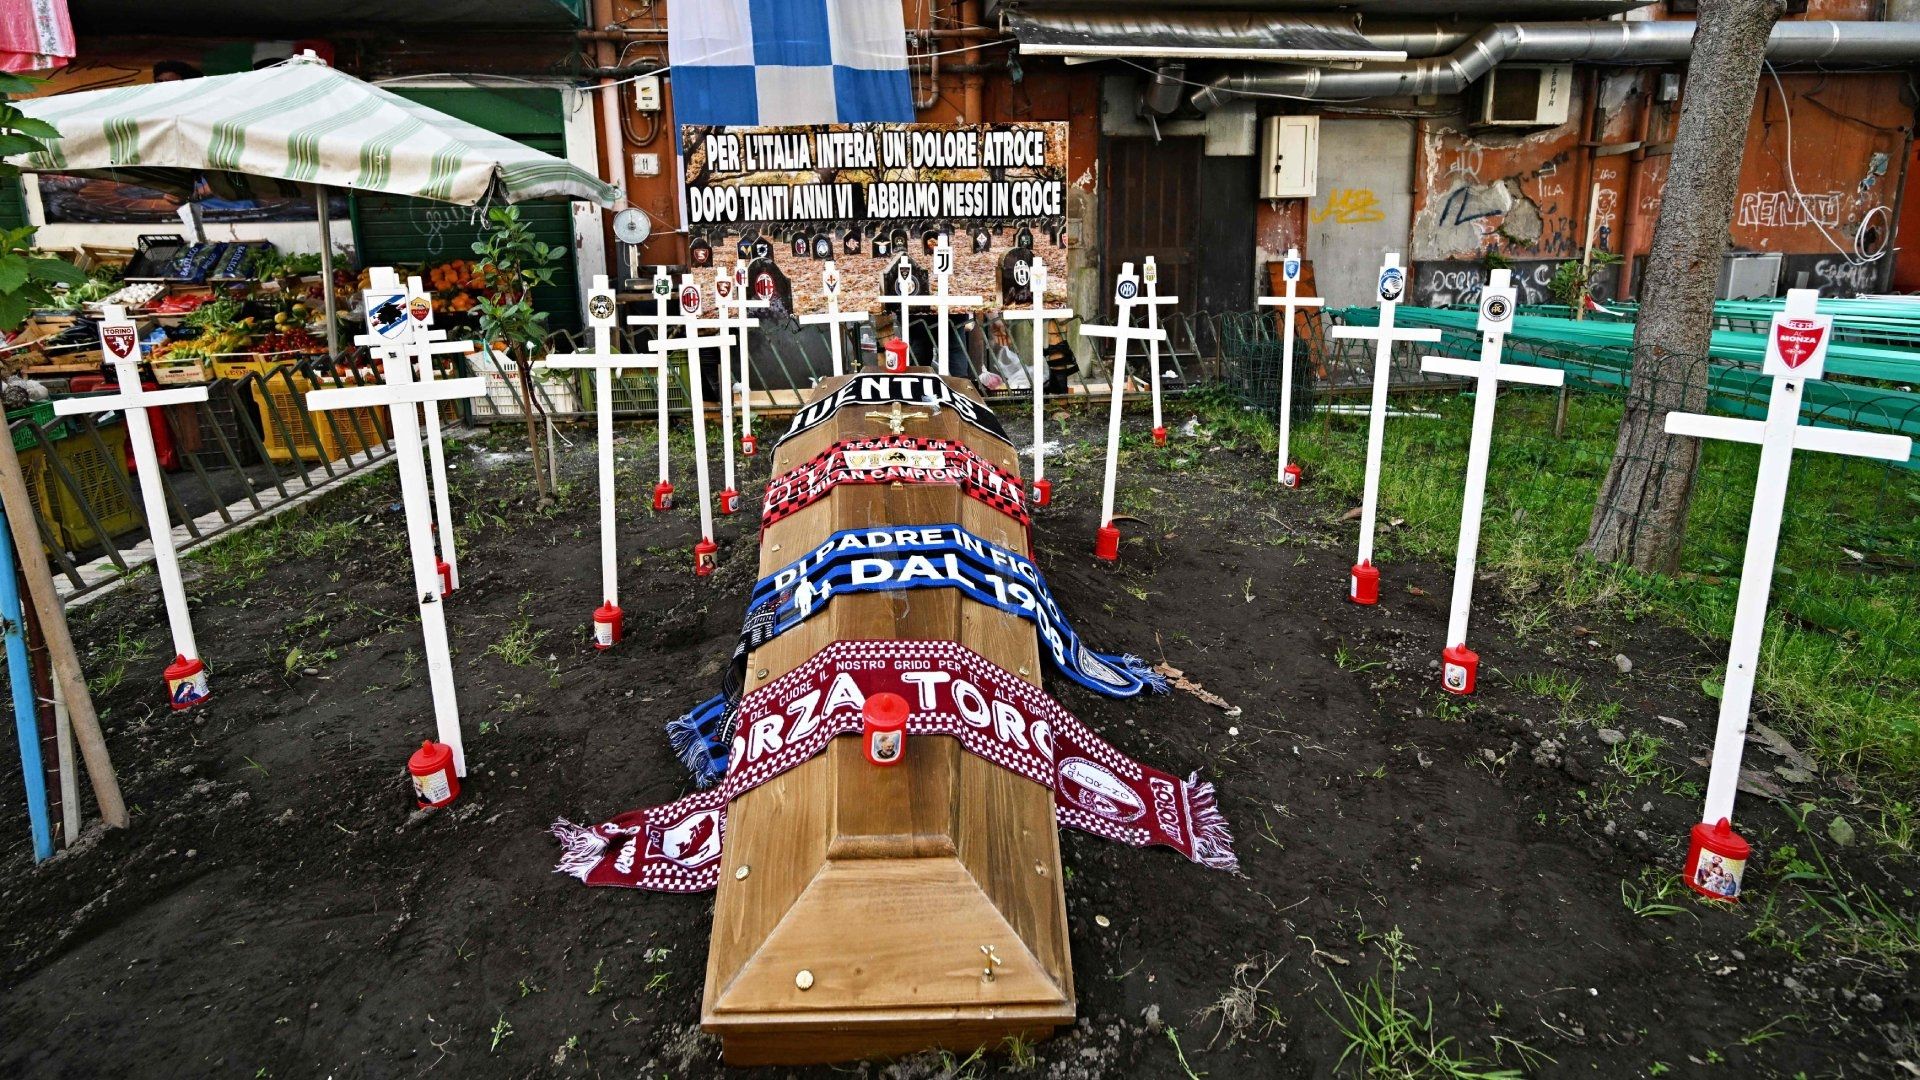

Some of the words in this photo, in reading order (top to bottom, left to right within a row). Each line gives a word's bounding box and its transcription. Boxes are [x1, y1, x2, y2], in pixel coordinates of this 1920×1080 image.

[706, 134, 740, 171] PER
[745, 134, 812, 171] L'ITALIA
[816, 132, 877, 168] INTERA
[882, 131, 906, 168] UN
[912, 131, 977, 168] DOLORE
[983, 131, 1044, 167] ATROCE
[689, 186, 738, 222] DOPO
[739, 185, 789, 221] TANTI
[792, 184, 833, 219] ANNI
[835, 183, 853, 219] VI
[867, 182, 939, 218] ABBIAMO
[943, 182, 988, 217] MESSI
[991, 181, 1009, 216] IN
[1011, 181, 1061, 216] CROCE
[1780, 335, 1816, 344] MONZA
[929, 441, 947, 449] UN
[808, 470, 865, 499] MILAN
[774, 559, 807, 592] DI
[816, 529, 946, 565] PADRE
[953, 528, 986, 559] IN
[989, 547, 1062, 624] FIGLIO
[851, 553, 976, 586] DAL
[984, 574, 1065, 666] 1908
[750, 706, 772, 723] DEL
[779, 679, 814, 707] CUORE
[819, 671, 830, 684] IL
[835, 659, 886, 672] NOSTRO
[893, 660, 931, 670] GRIDO
[938, 660, 962, 673] PER
[1076, 770, 1130, 800] TORINO
